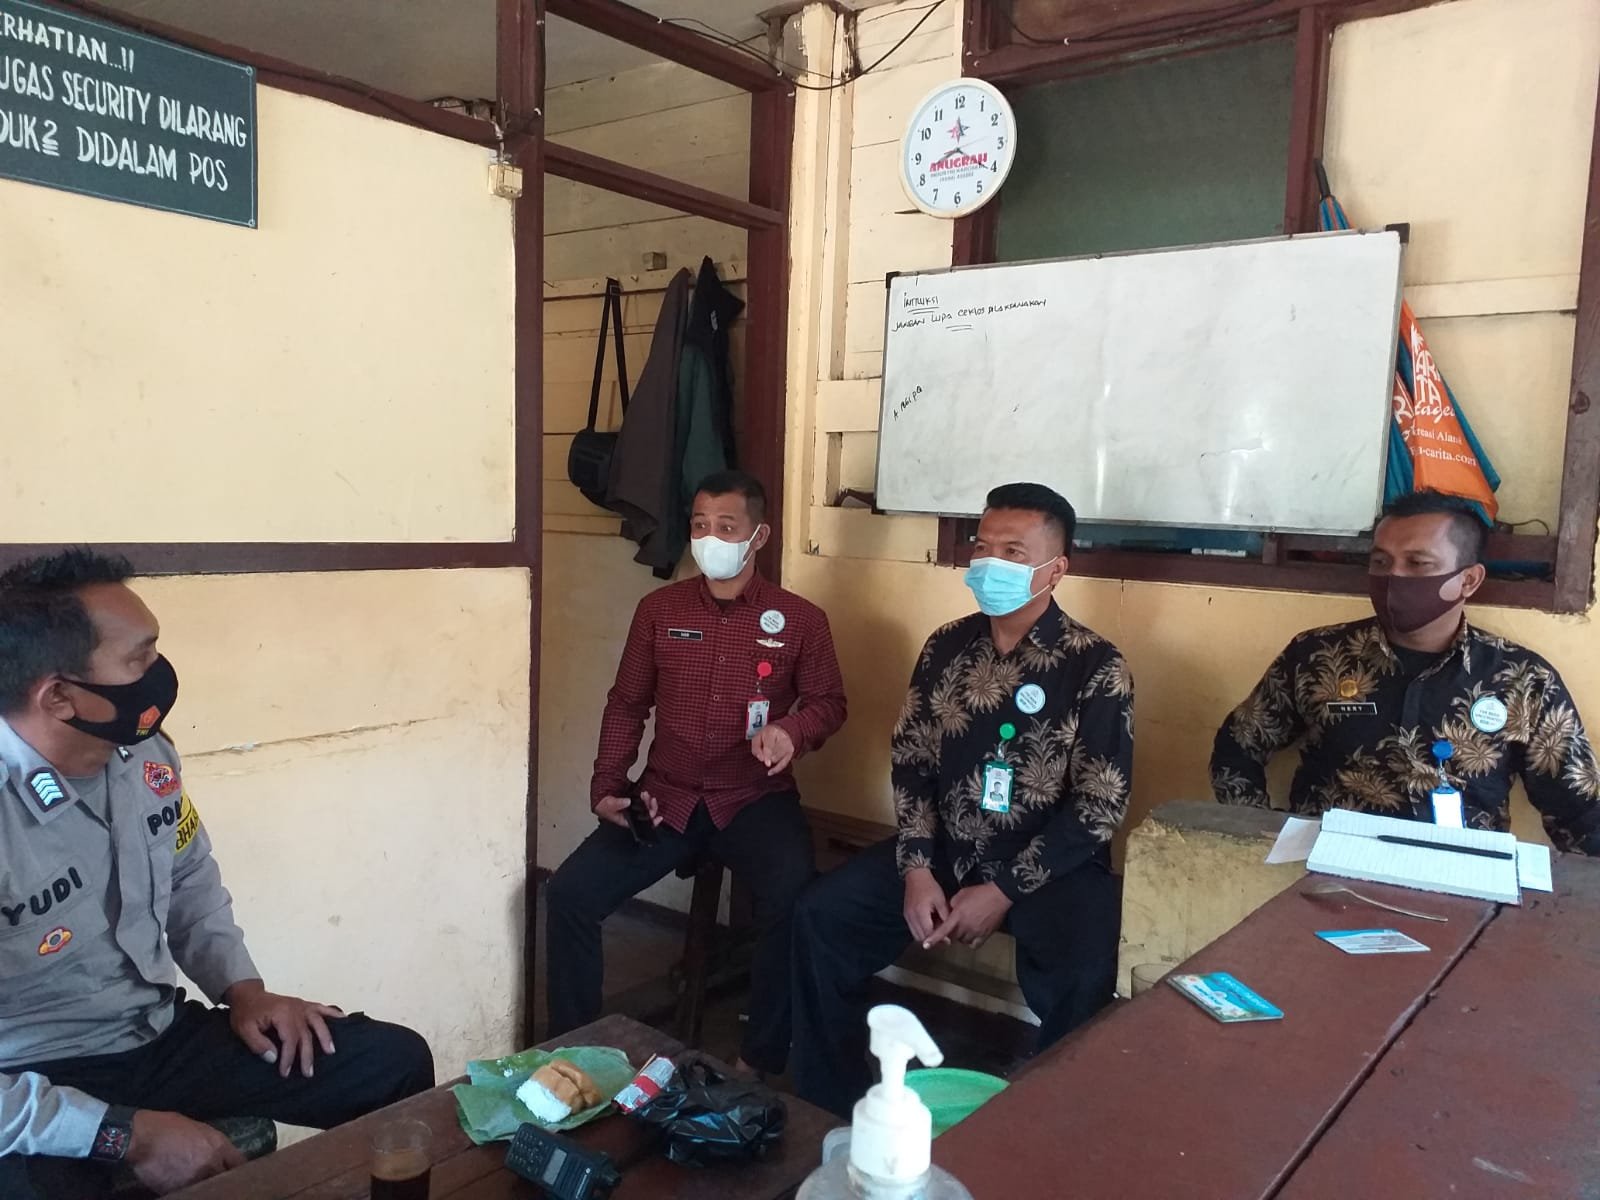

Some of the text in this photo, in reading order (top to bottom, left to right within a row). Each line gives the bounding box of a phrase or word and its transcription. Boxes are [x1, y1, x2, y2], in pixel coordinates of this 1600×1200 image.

[62, 70, 151, 125] SECURITY
[159, 95, 247, 148] DILARANG
[954, 95, 966, 110] 12
[934, 108, 943, 122] 11
[990, 113, 999, 127] 2
[921, 127, 932, 141] 10
[996, 136, 1004, 150] 3
[76, 125, 177, 182] DIDALAM
[189, 152, 229, 192] POS
[915, 152, 922, 165] 9
[929, 152, 988, 173] ANUGRAH
[990, 160, 998, 173] 4
[919, 174, 926, 186] 8
[976, 180, 983, 194] 5
[933, 188, 939, 202] 7
[953, 192, 961, 205] 6
[0, 866, 83, 927] YUDI
